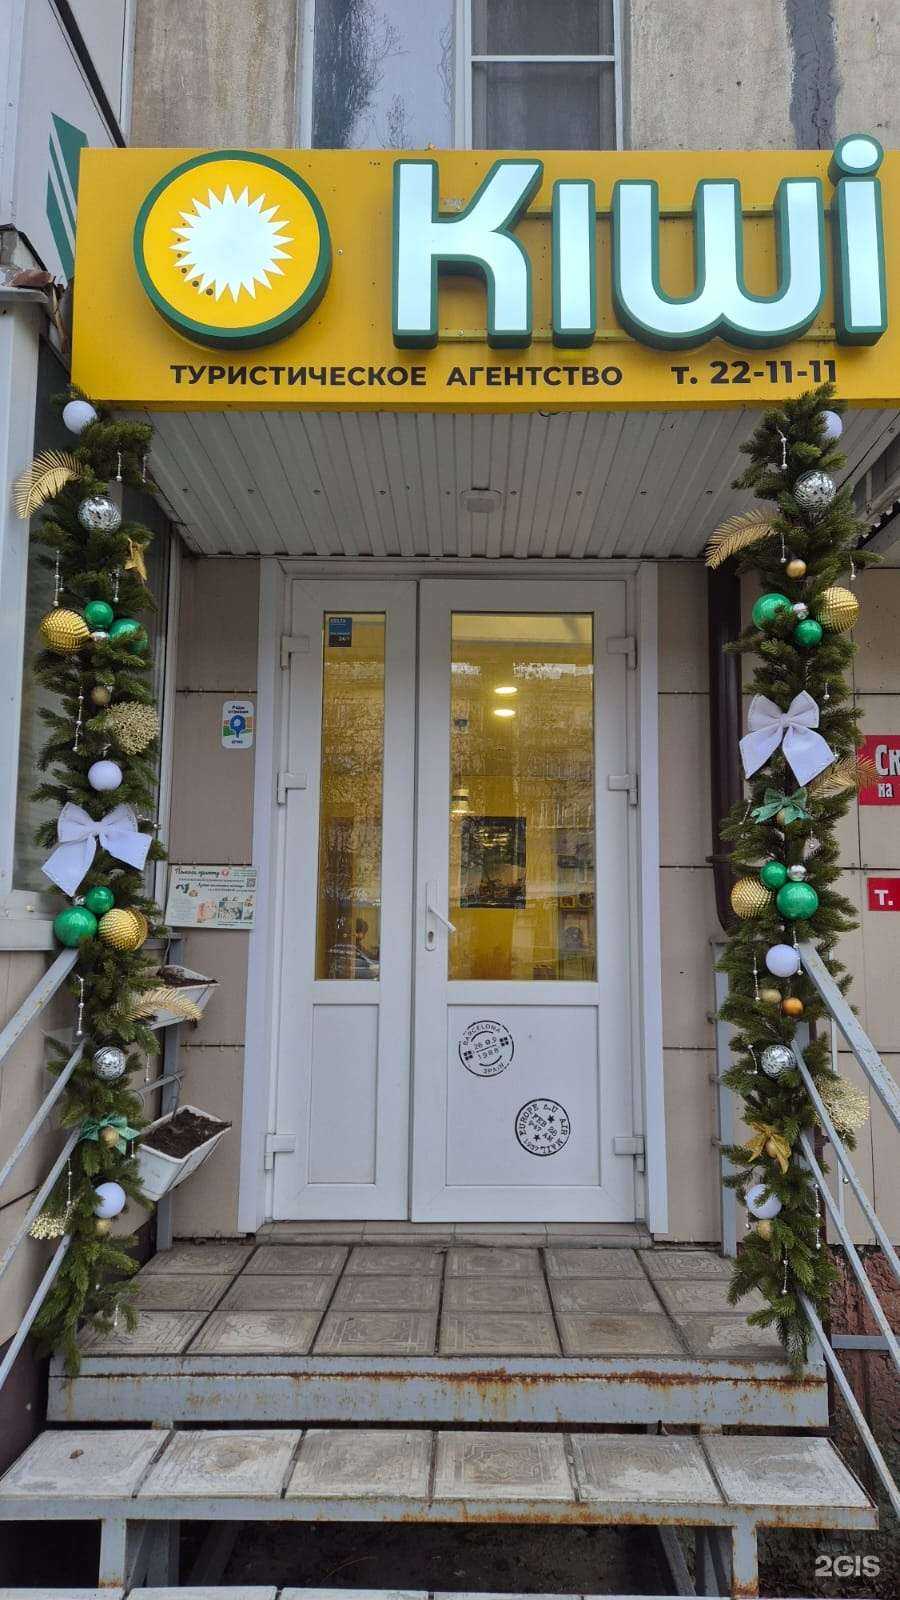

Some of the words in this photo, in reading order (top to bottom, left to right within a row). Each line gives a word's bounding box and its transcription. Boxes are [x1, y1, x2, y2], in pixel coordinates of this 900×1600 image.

[170, 364, 427, 387] ТУРИСТИЧЕСКОЕ
[446, 365, 623, 387] АГЕНТСТВО
[709, 359, 837, 385] 22-11-11
[519, 1103, 539, 1136] EUROPE
[559, 1118, 568, 1136] AIR
